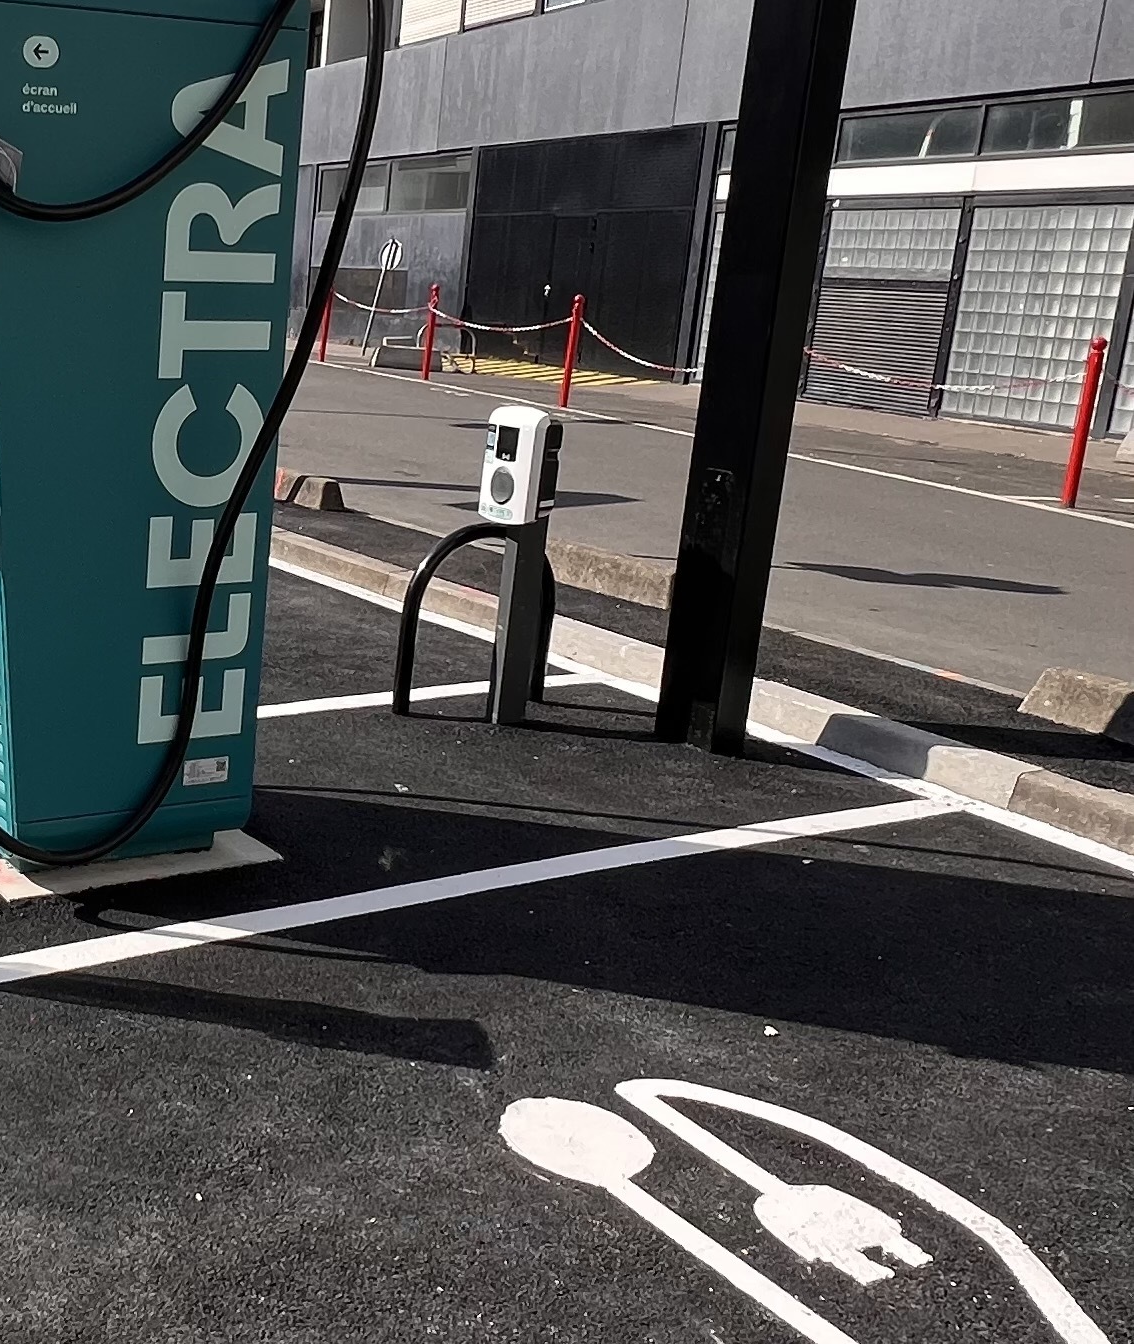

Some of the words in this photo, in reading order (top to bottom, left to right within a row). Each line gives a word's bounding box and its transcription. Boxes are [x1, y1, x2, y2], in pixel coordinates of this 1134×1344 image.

[22, 82, 58, 97] écran
[22, 100, 77, 115] d'accueil
[137, 58, 290, 746] ELECTRA
